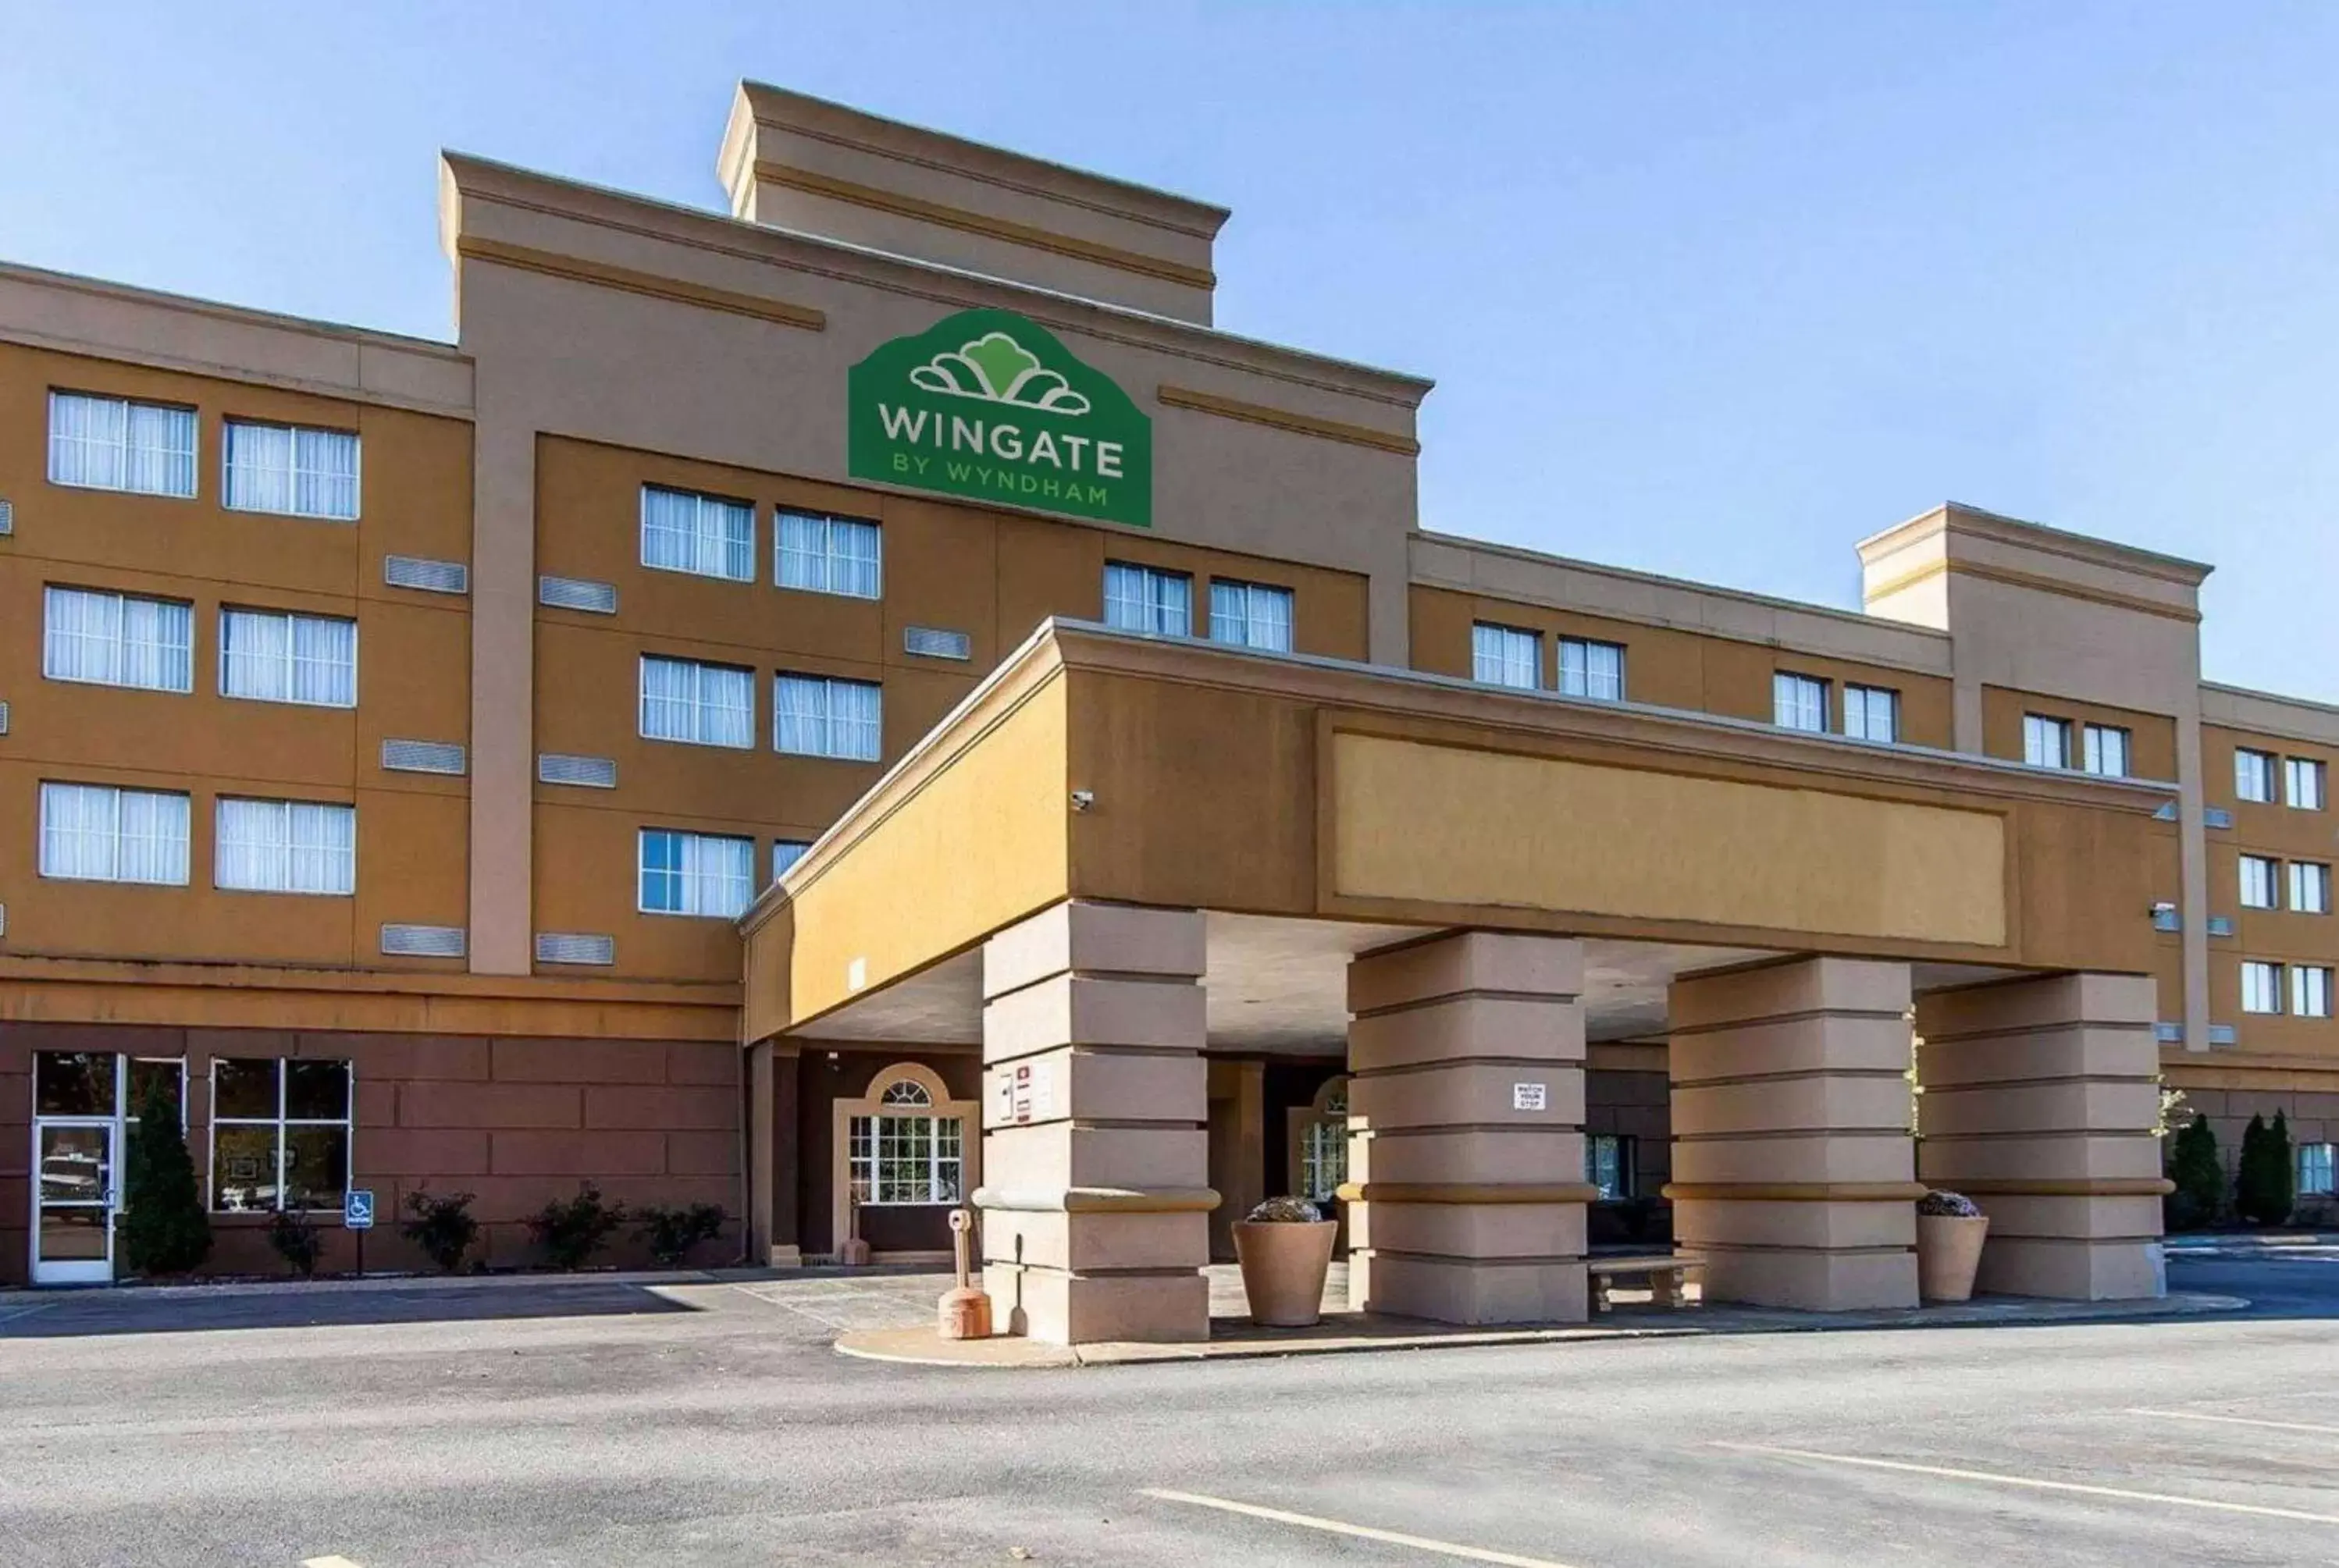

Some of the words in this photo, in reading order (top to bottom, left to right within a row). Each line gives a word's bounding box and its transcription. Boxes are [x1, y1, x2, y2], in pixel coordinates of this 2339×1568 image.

[878, 404, 1123, 478] WINGATE
[893, 453, 931, 475] BY
[947, 462, 1108, 507] WYNDHAM
